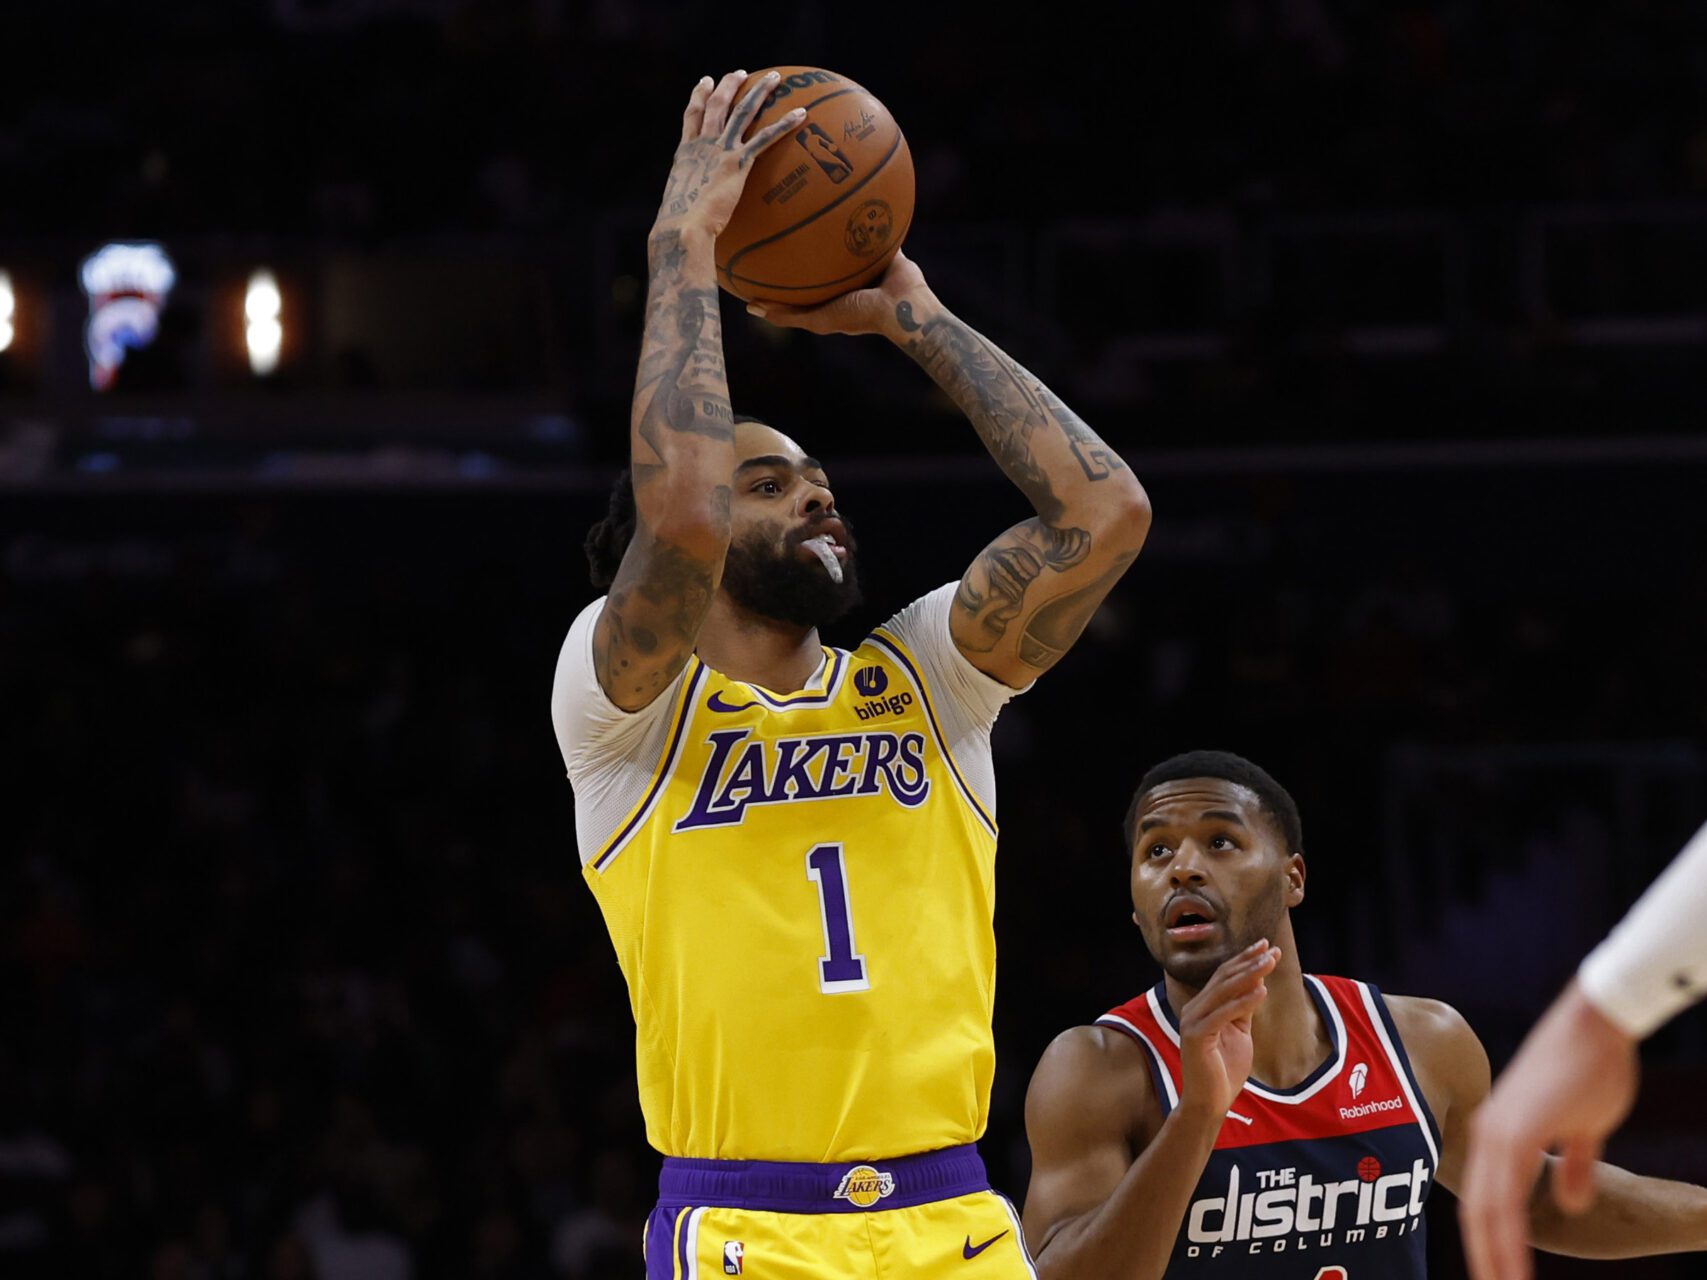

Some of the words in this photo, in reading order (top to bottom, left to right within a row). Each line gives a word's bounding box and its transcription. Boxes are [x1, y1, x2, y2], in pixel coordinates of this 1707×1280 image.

[853, 692, 912, 720] bibigo
[671, 727, 932, 834] LAKERS
[805, 842, 870, 994] 1
[1339, 1095, 1403, 1119] Robinhood
[834, 1175, 895, 1198] LAKERS
[1256, 1167, 1296, 1188] THE
[1187, 1157, 1429, 1245] district
[1187, 1245, 1224, 1258] OF
[1249, 1217, 1420, 1255] COLUMBIA
